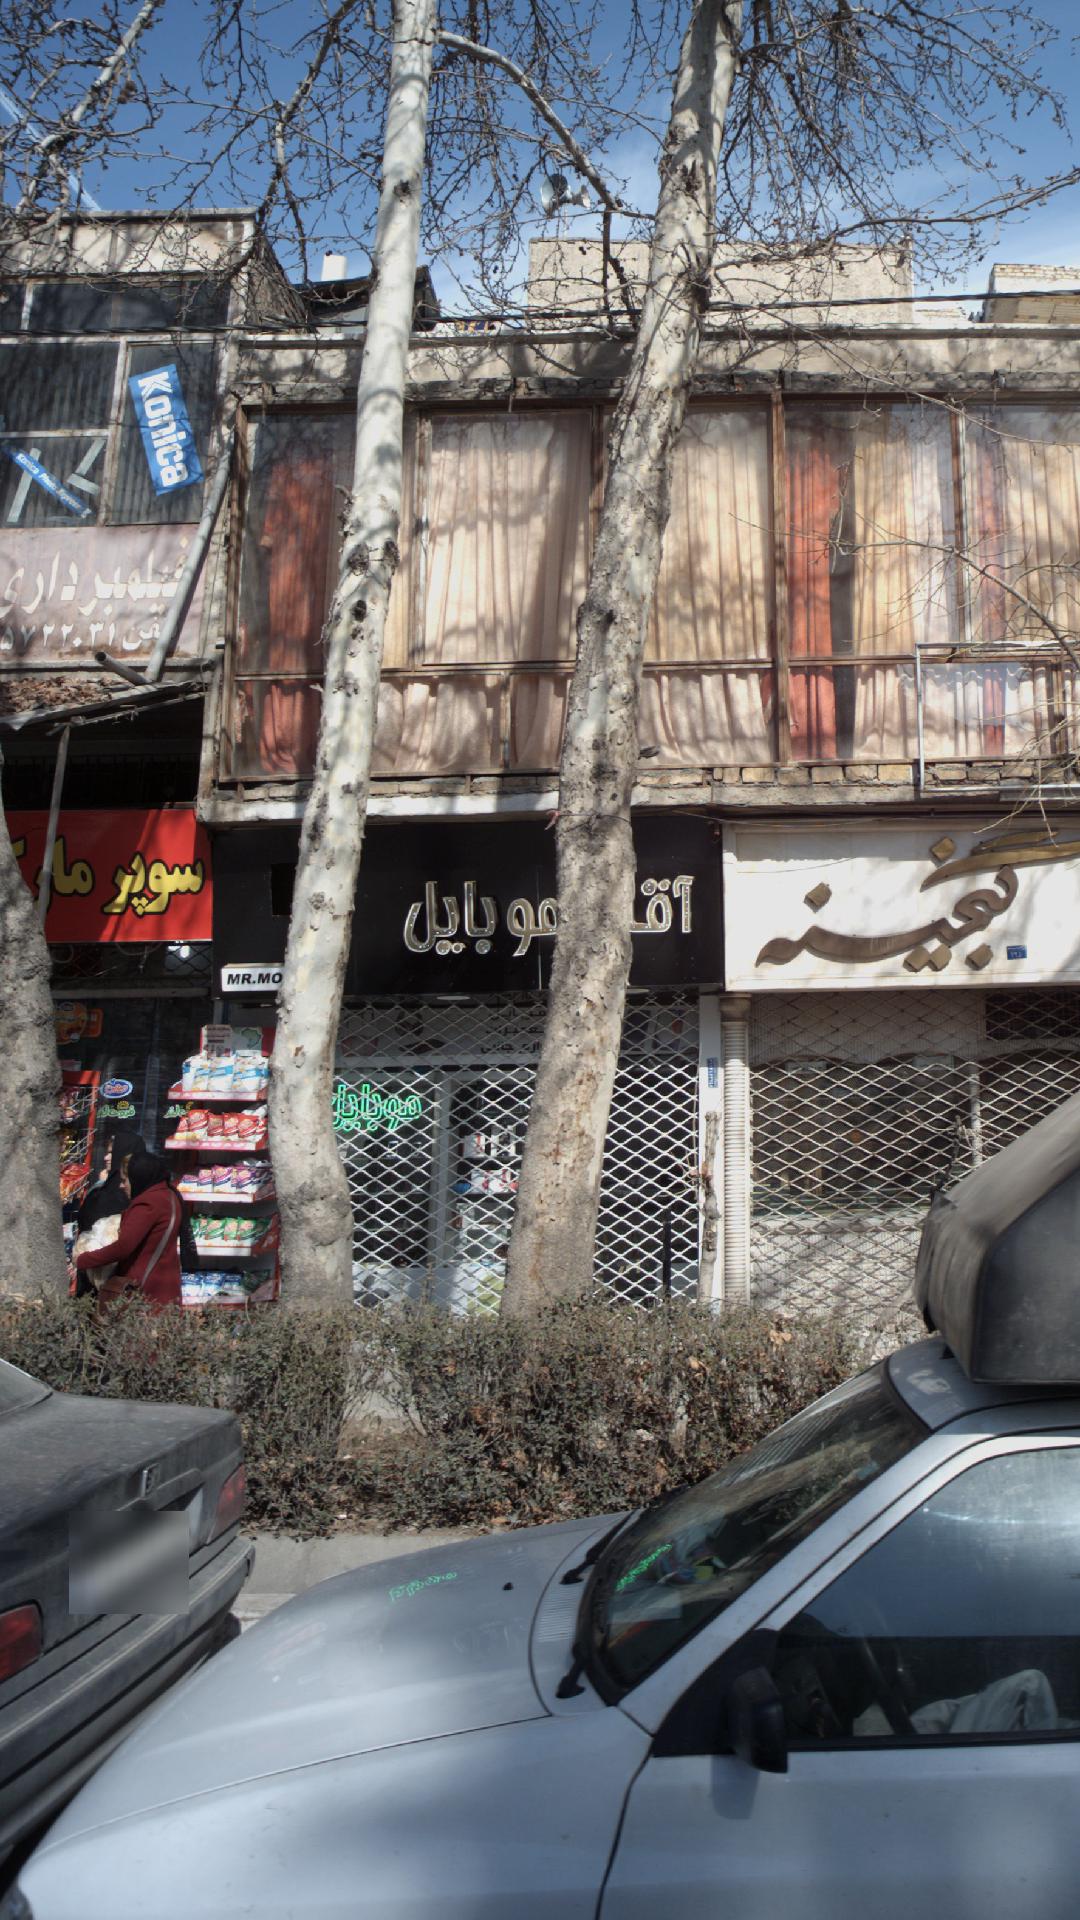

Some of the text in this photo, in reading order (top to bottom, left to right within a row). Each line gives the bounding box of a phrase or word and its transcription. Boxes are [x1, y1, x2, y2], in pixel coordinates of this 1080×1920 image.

[137, 371, 188, 487] Konica
[15, 453, 40, 474] Konica
[103, 853, 203, 915] سوپر
[403, 874, 695, 957] آق موبایل
[226, 972, 283, 985] MR.MO
